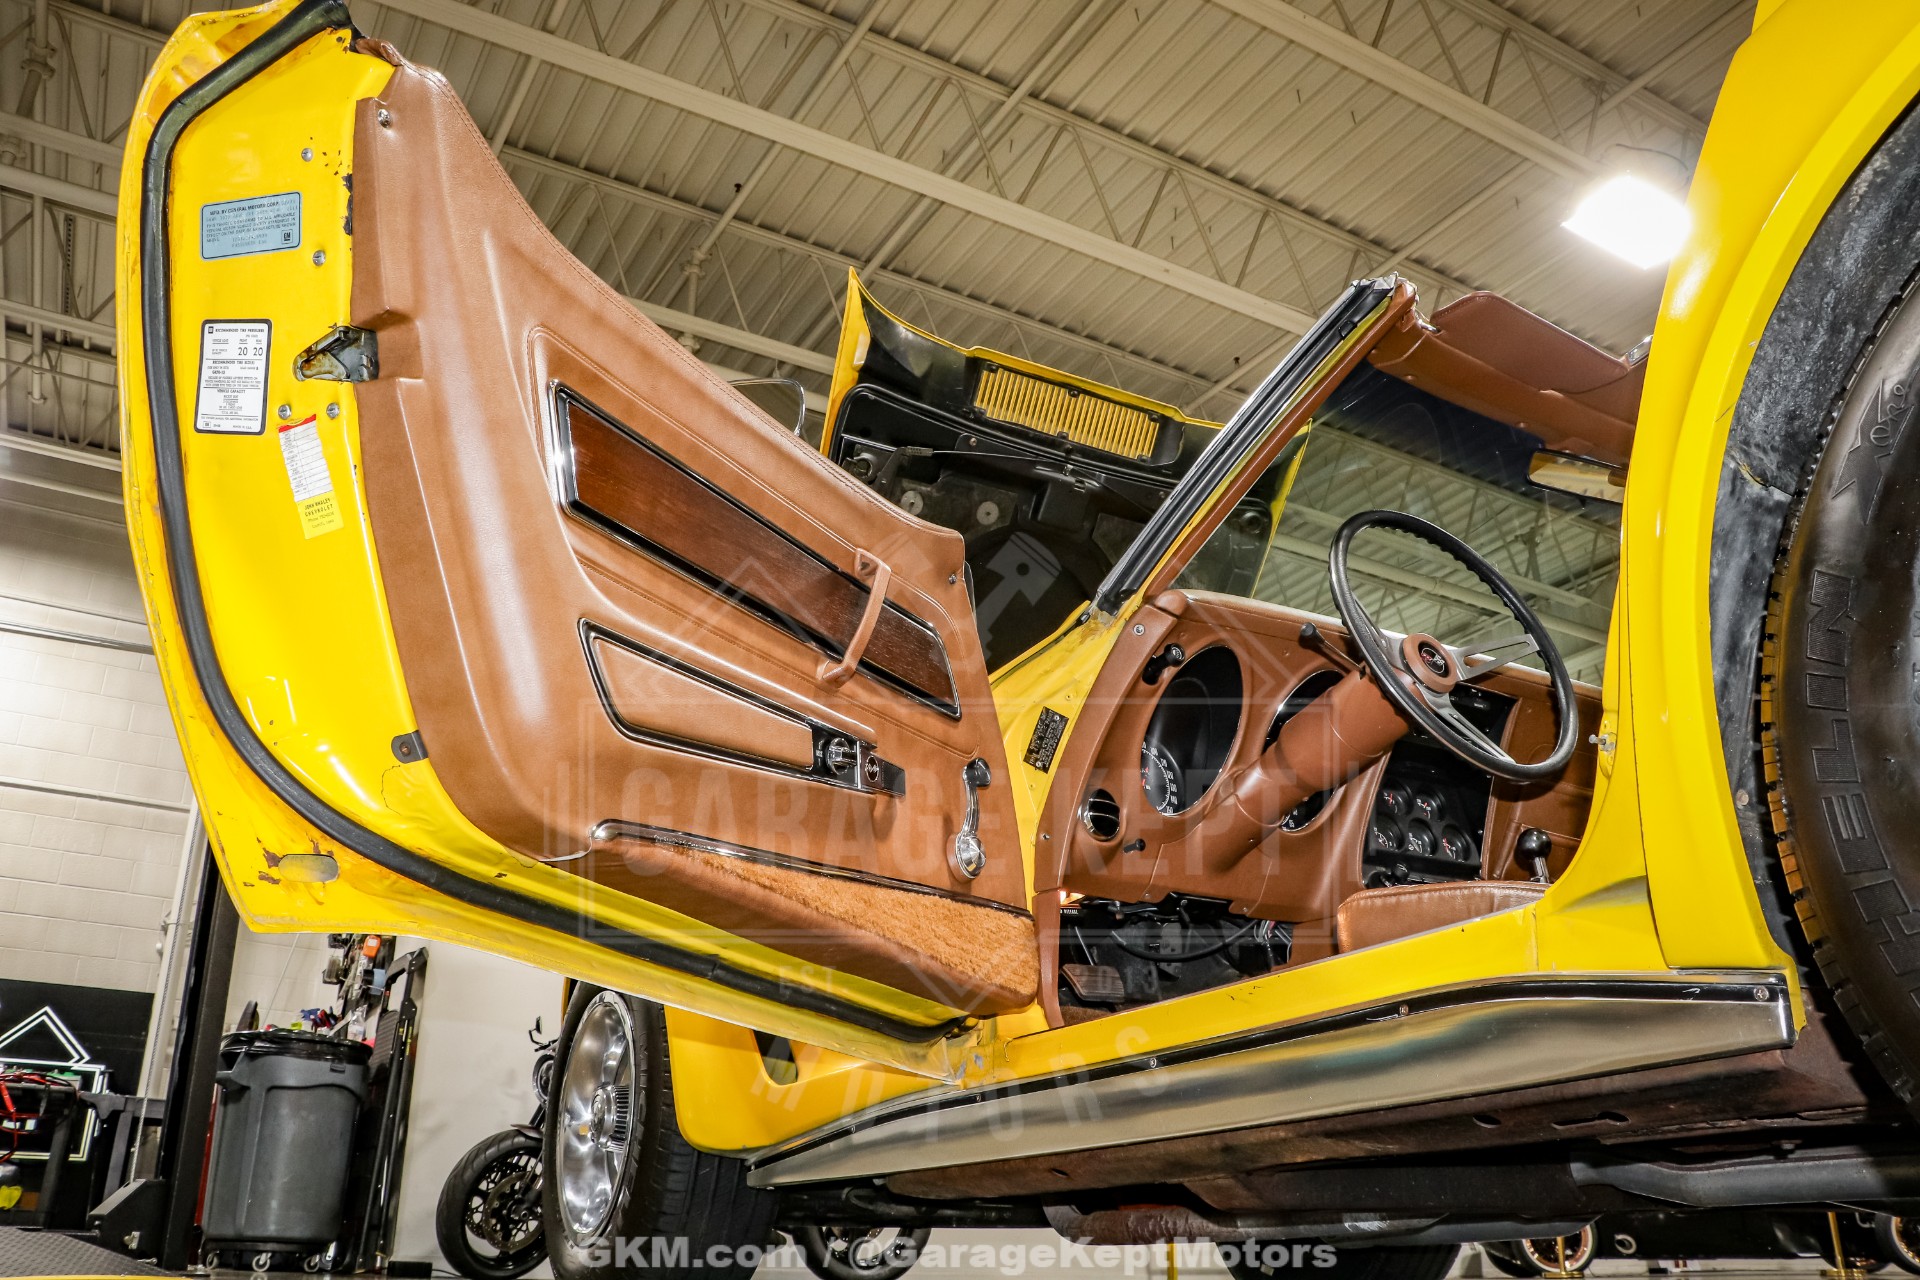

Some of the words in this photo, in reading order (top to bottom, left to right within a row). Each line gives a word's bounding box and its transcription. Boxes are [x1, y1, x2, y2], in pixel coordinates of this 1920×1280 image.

[238, 346, 248, 356] 20
[253, 346, 264, 356] 20
[305, 503, 333, 516] CHEVROLET
